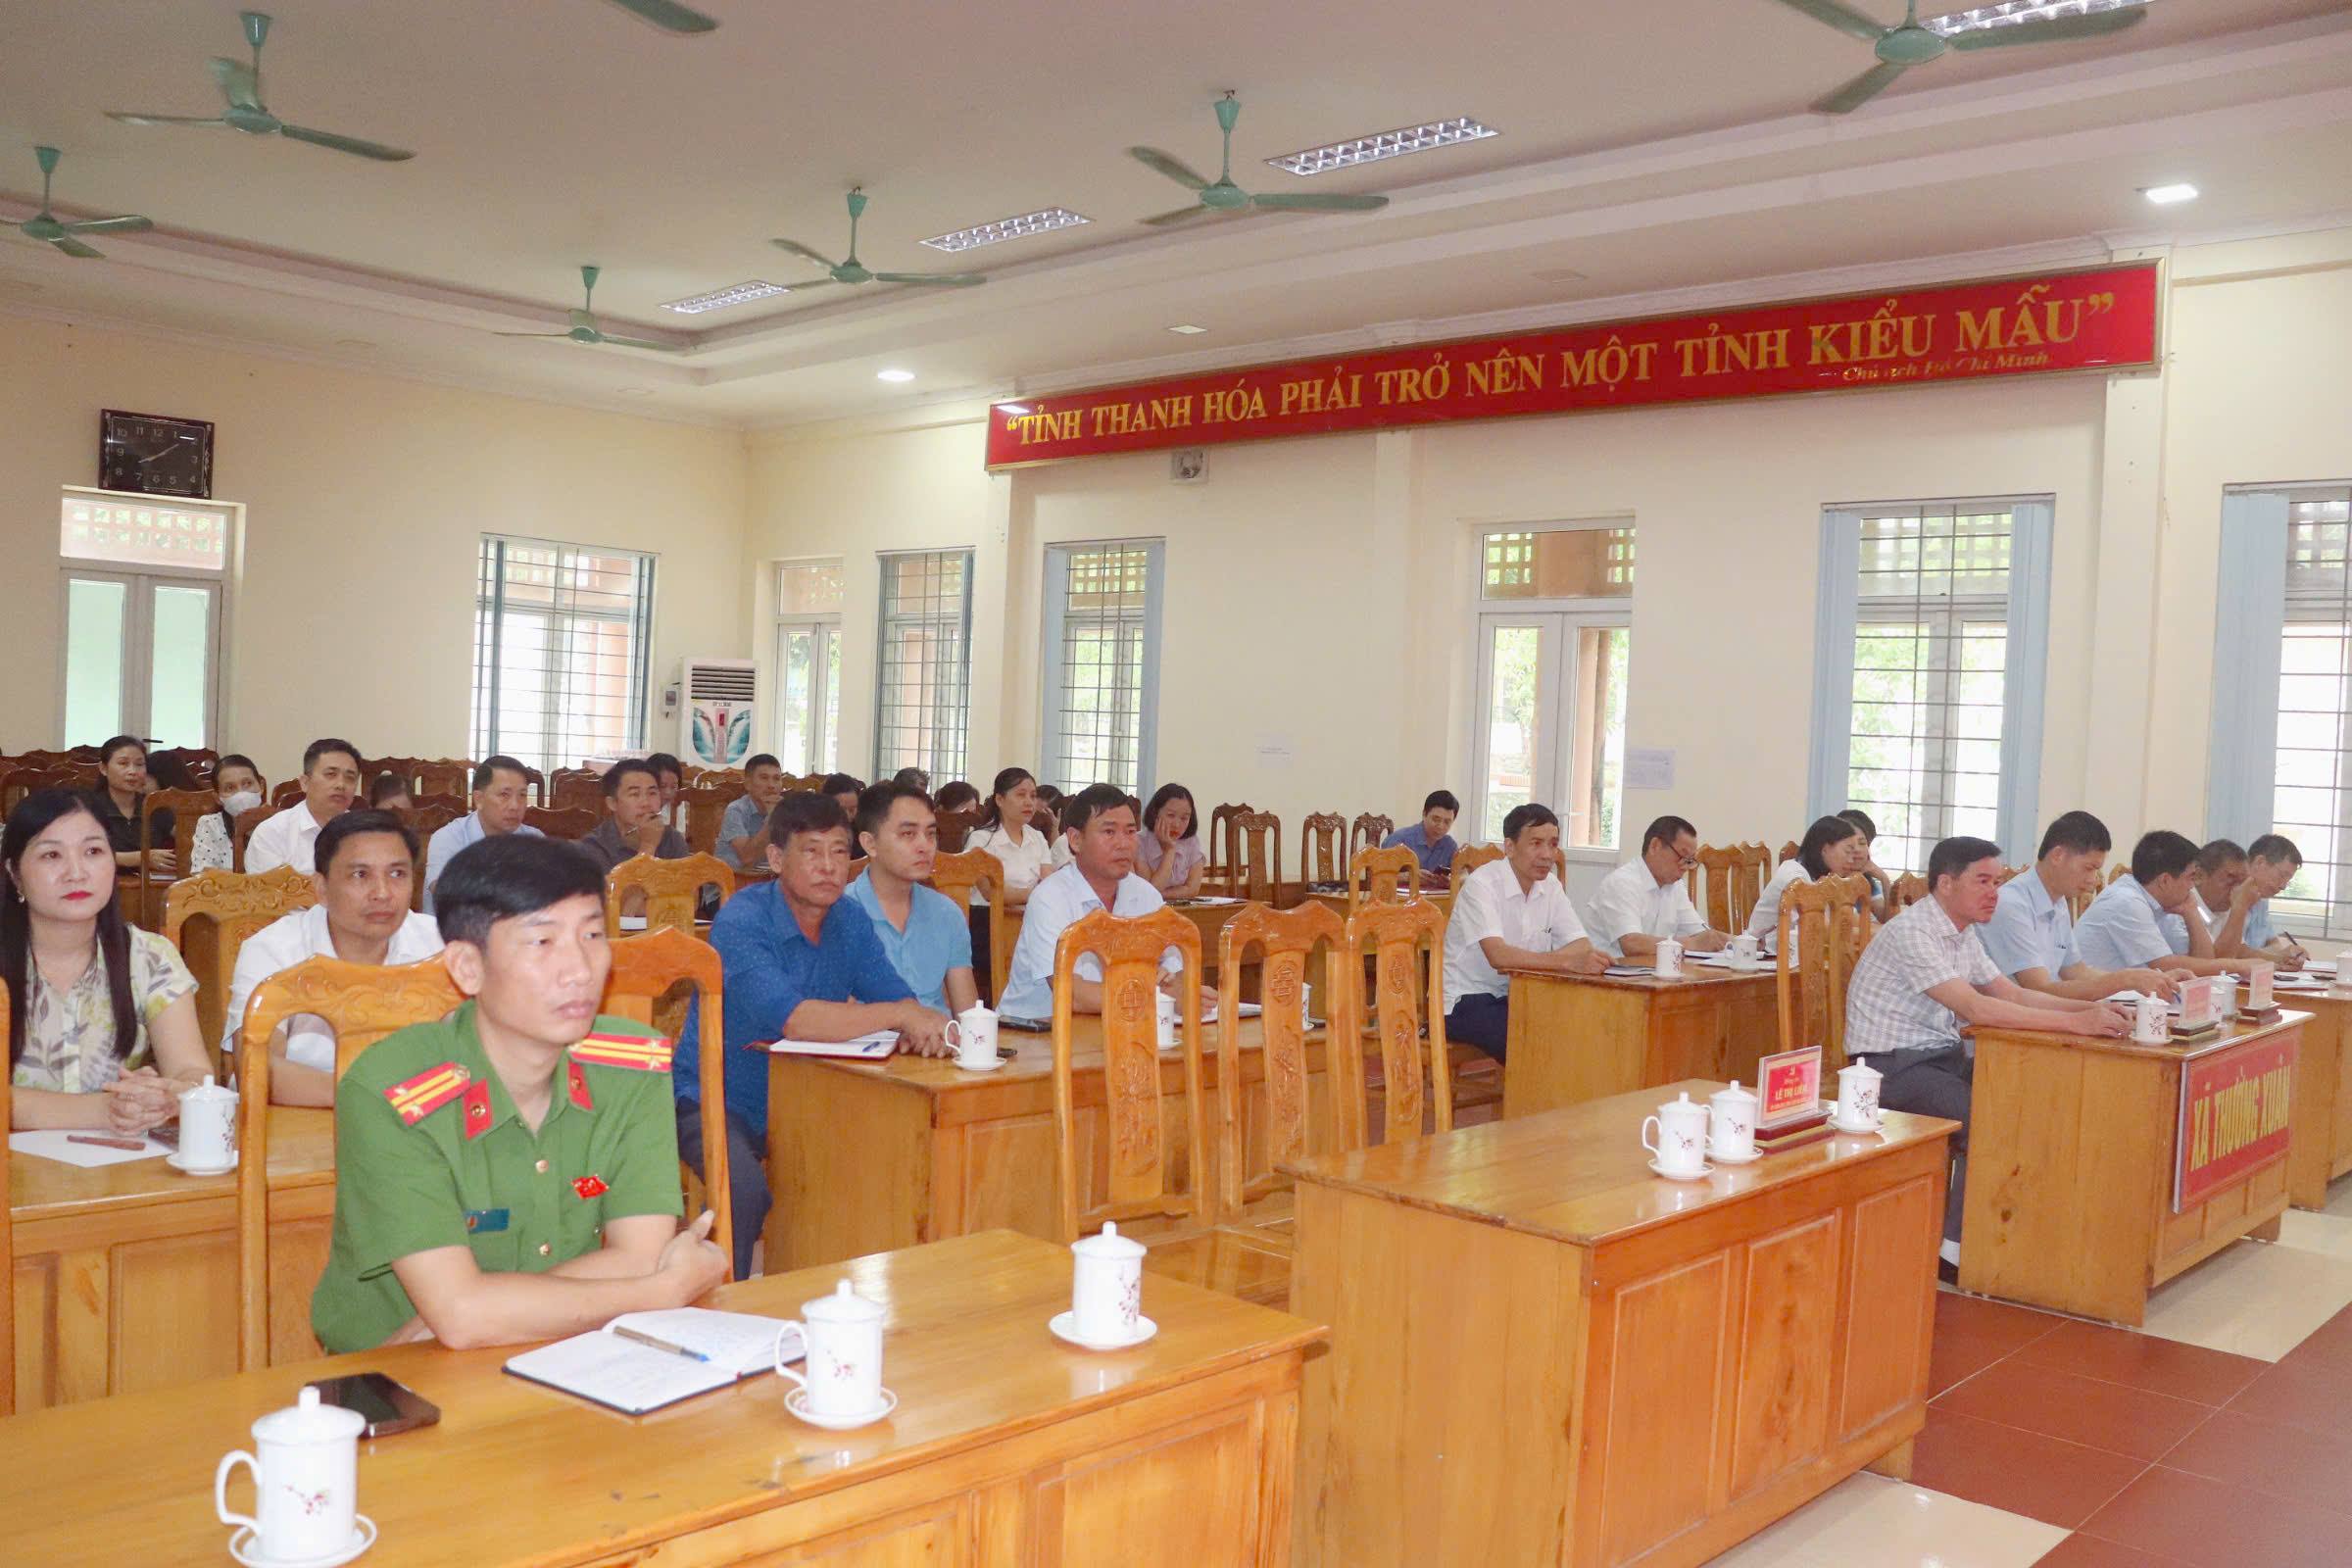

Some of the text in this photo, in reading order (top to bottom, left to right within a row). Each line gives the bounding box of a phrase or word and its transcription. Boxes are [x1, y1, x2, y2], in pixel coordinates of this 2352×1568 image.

[1006, 283, 2116, 445] “TỈNH THANH HÓA PHẢI TRỞ NÊN MỘT TỈNH KIỂU MẪU”
